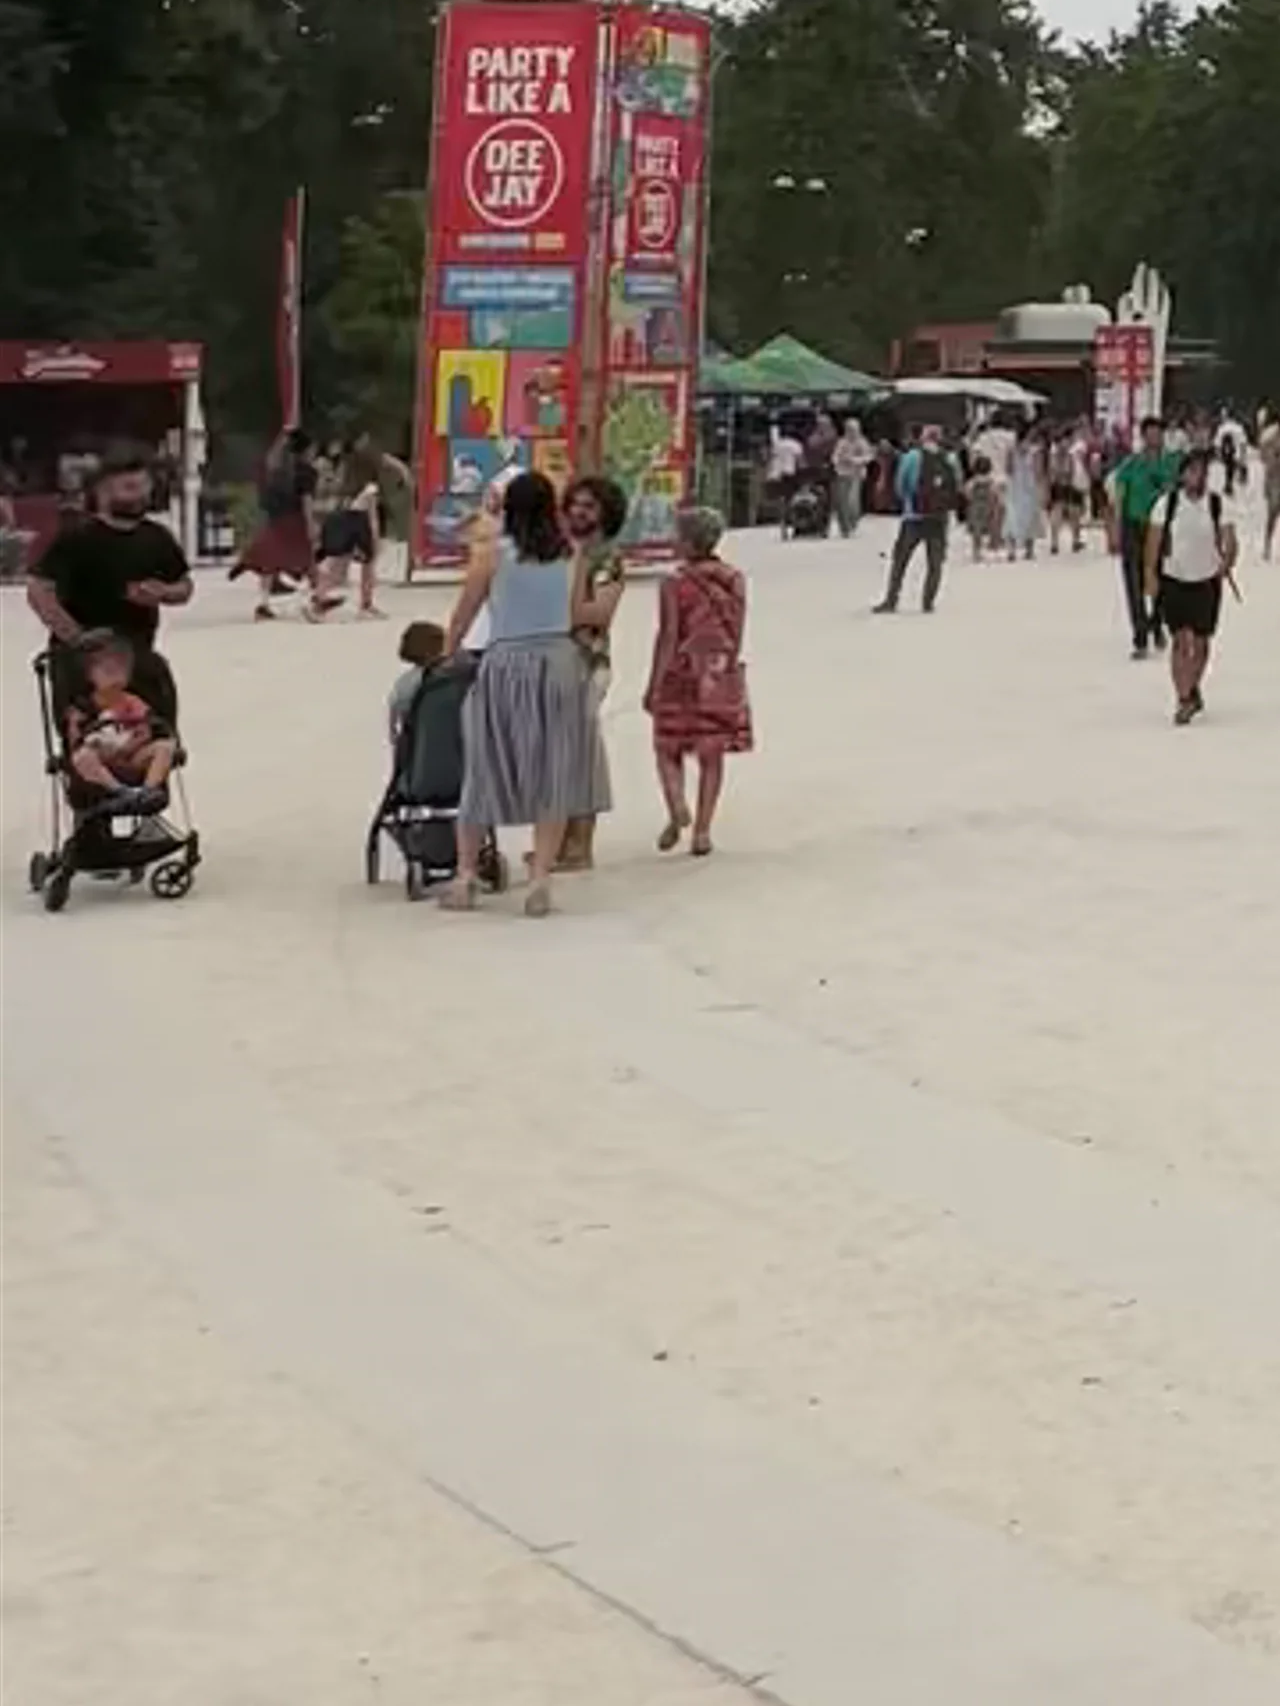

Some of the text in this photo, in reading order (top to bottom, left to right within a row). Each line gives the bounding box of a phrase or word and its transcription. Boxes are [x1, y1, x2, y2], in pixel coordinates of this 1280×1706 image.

[468, 46, 576, 78] PARTY
[465, 80, 572, 114] LIKE A
[485, 139, 546, 173] DEE
[483, 175, 544, 206] JAY
